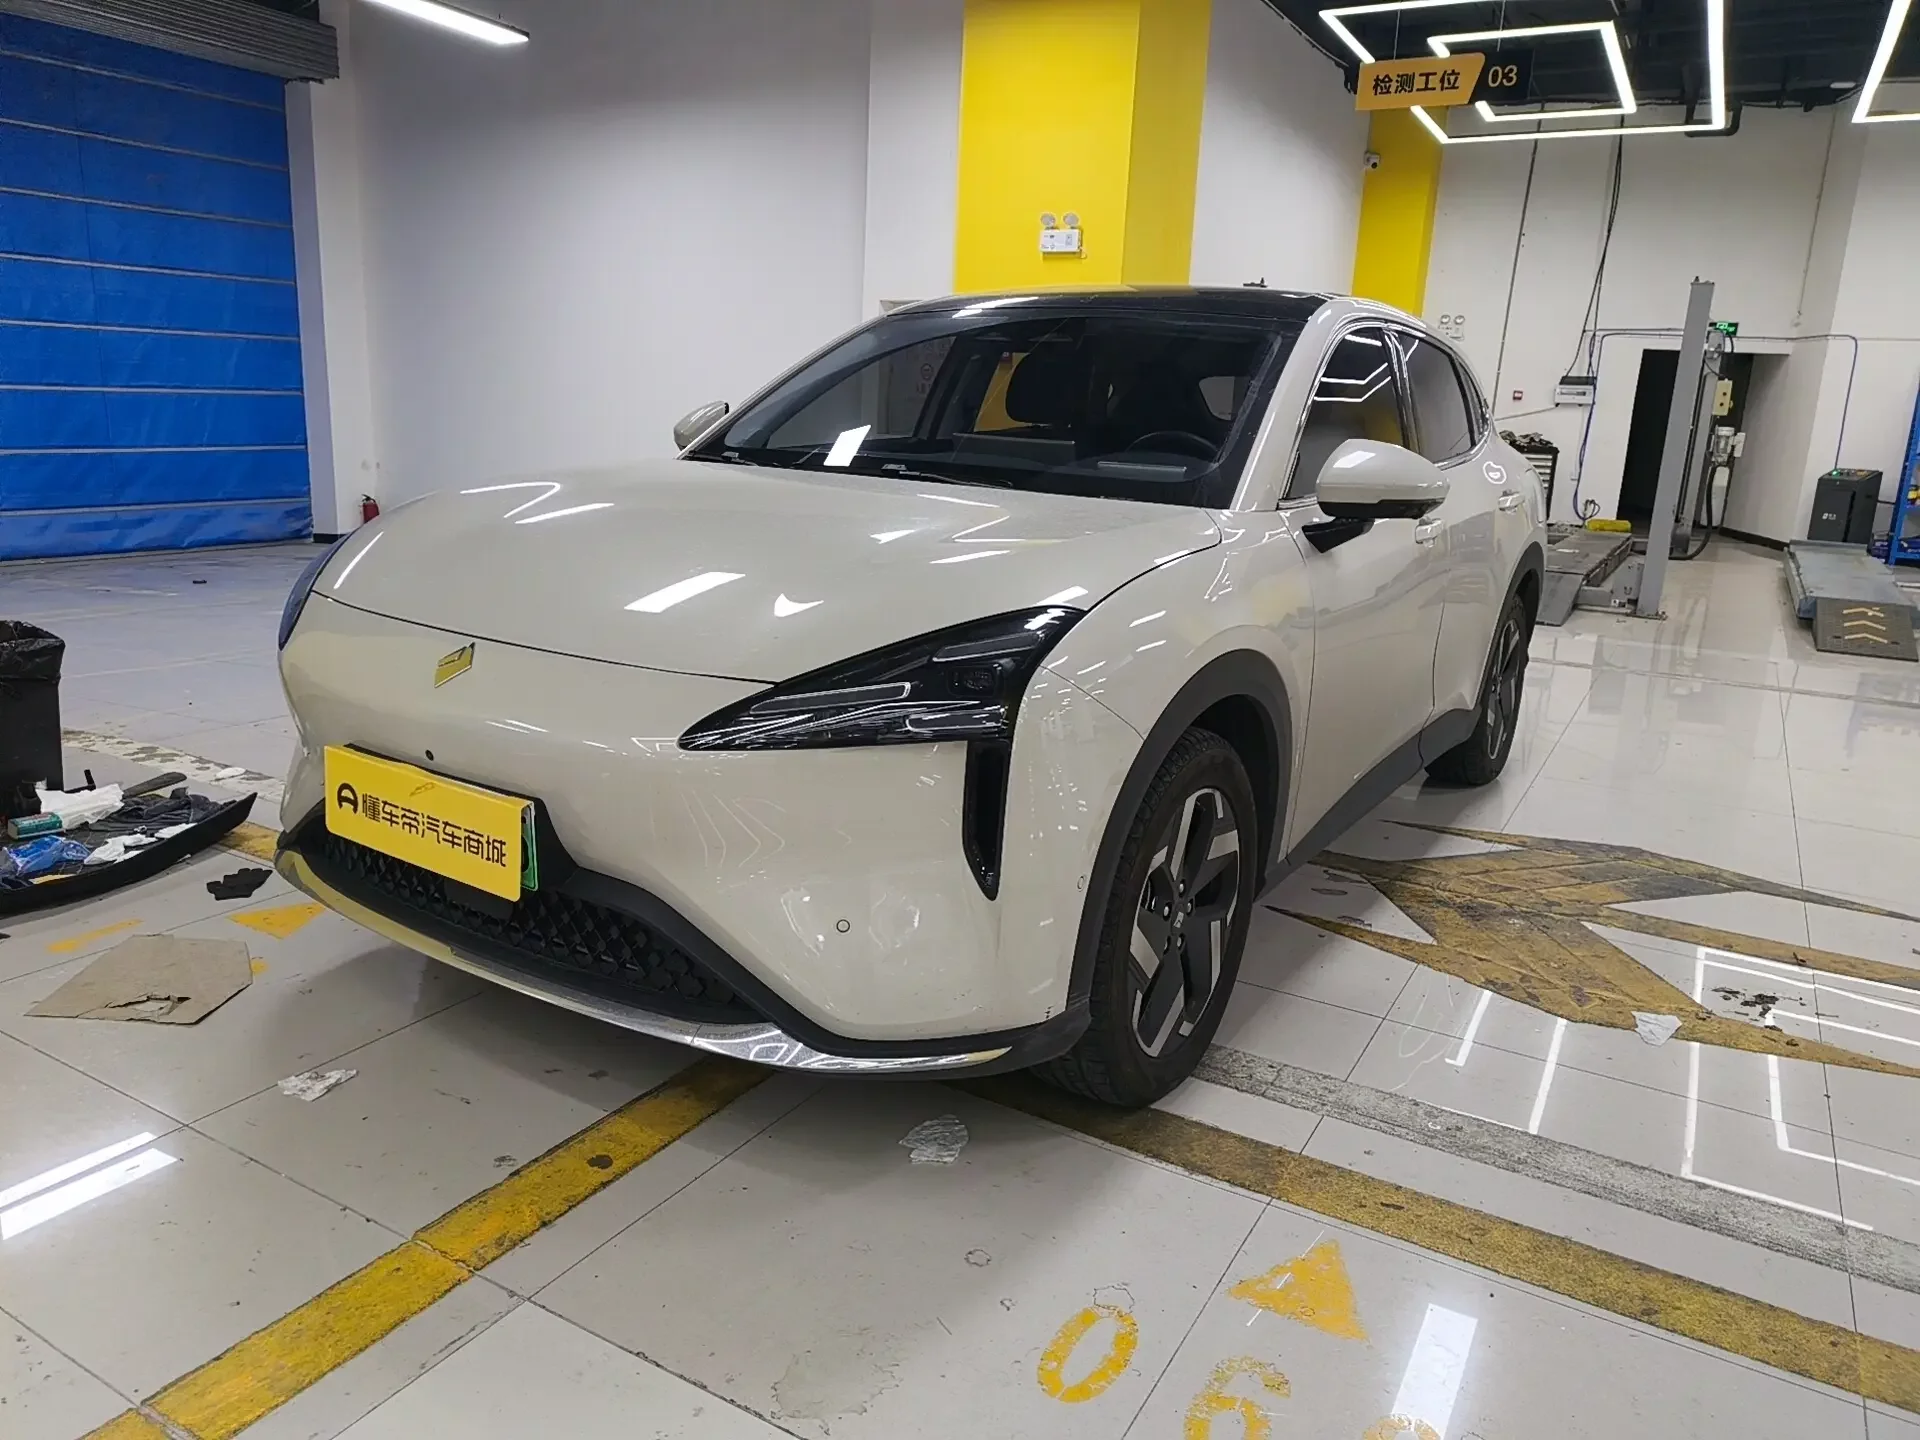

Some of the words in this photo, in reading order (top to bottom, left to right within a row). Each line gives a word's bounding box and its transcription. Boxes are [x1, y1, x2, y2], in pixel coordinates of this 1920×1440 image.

[1372, 69, 1460, 96] 检测工位
[1488, 65, 1517, 87] 03
[362, 793, 507, 867] 懂车帝汽车商城
